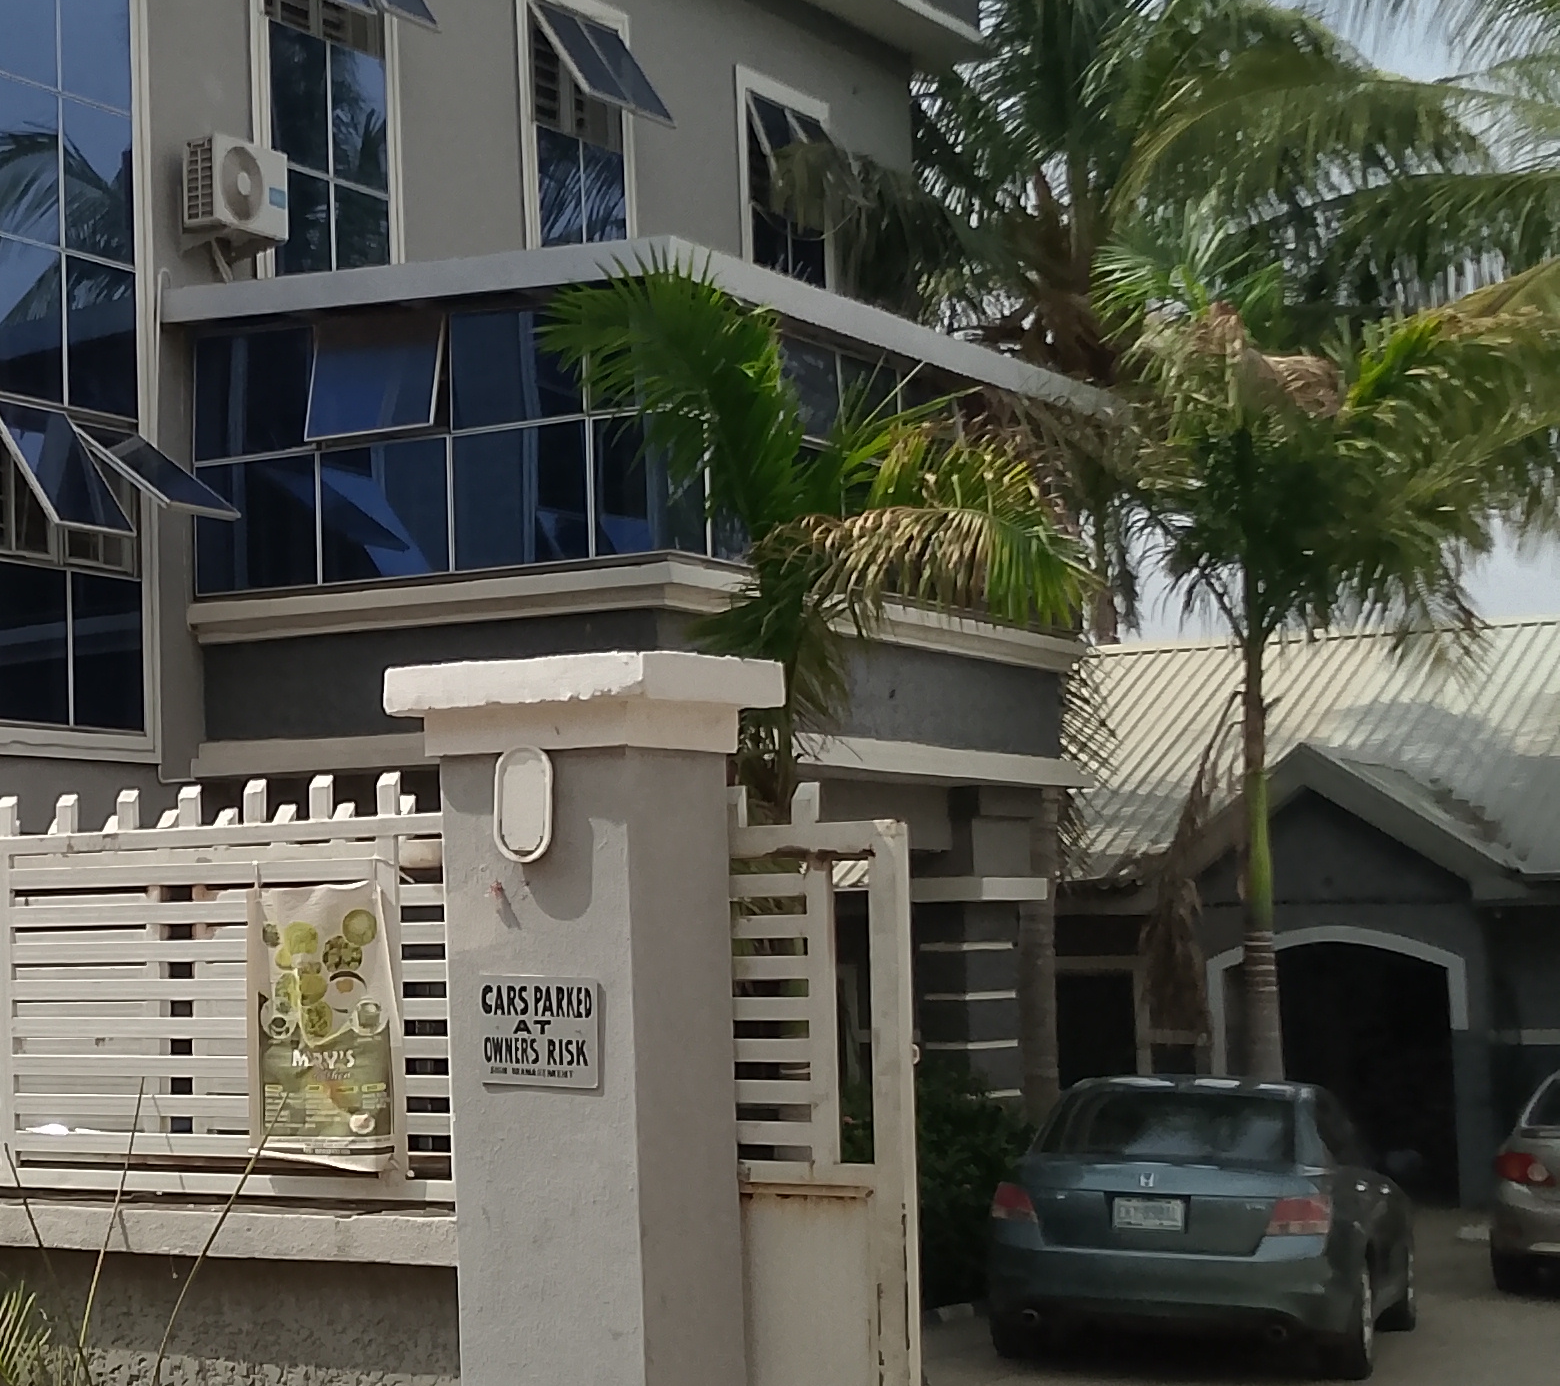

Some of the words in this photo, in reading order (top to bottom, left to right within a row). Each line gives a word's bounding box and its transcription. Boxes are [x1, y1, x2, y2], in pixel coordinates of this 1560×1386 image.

[481, 984, 529, 1016] CARS
[533, 985, 592, 1018] PARKED
[513, 1019, 552, 1035] AT
[547, 1038, 589, 1067] RISK
